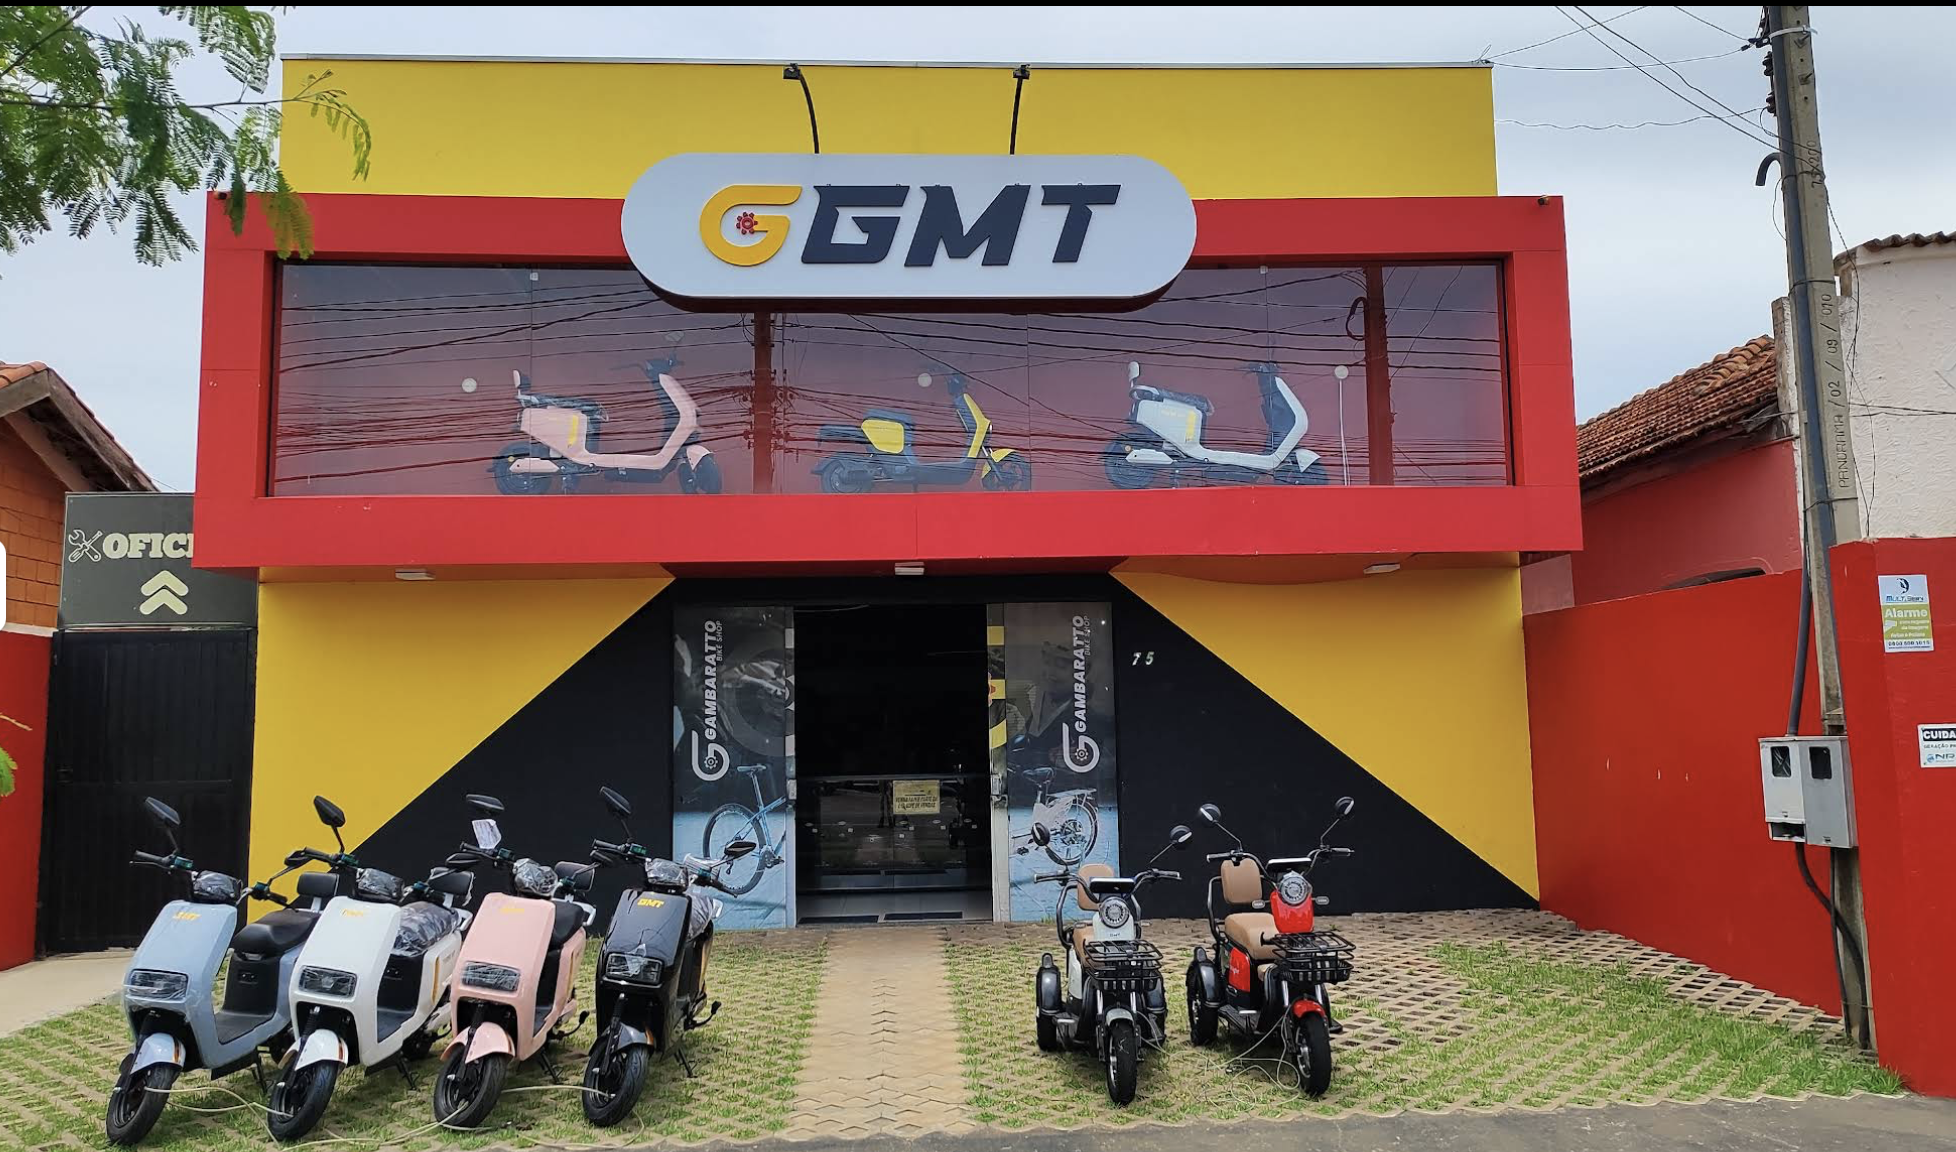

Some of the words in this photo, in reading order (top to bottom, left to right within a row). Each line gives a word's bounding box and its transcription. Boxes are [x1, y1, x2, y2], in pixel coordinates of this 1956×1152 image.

[801, 184, 1121, 266] GMT
[1885, 608, 1928, 618] Alarme
[704, 620, 717, 740] GAMBARATTO
[1072, 615, 1087, 733] GAMBARATTO
[637, 898, 665, 908] GMT
